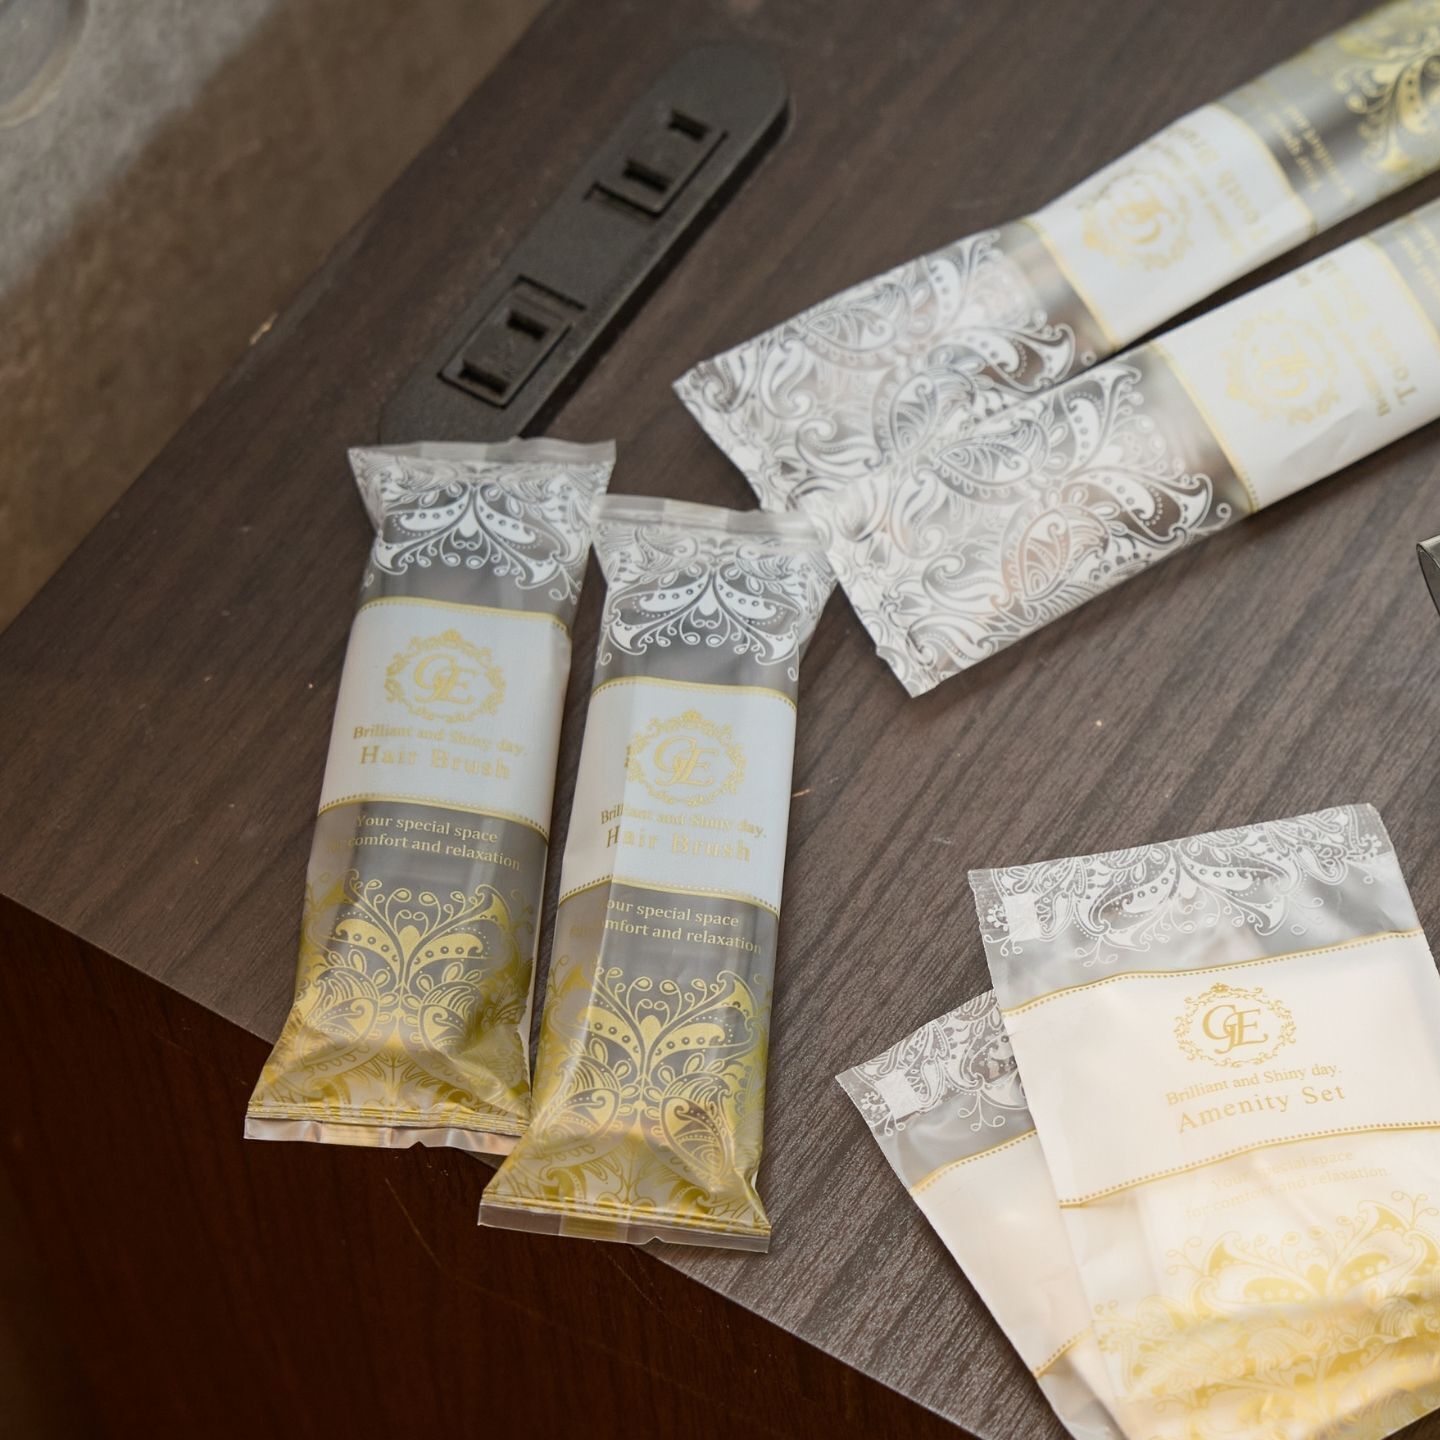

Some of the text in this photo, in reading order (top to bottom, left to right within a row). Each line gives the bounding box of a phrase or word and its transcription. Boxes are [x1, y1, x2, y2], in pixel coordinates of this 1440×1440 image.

[417, 728, 445, 741] and
[360, 745, 510, 780] Hair Brush
[356, 815, 499, 843] Your special space
[656, 813, 686, 825] and
[691, 814, 732, 833] Shiny
[348, 833, 409, 848] comfort
[412, 840, 441, 853] and
[606, 825, 751, 862] Hair Brush
[606, 899, 739, 928] our special space
[652, 927, 682, 941] and
[686, 930, 763, 955] relaxation
[1165, 1076, 1228, 1106] Brilliant
[1233, 1073, 1260, 1088] and
[1264, 1067, 1307, 1084] Shiny
[1178, 1084, 1346, 1134] Amenity Set
[1311, 1151, 1353, 1168] space
